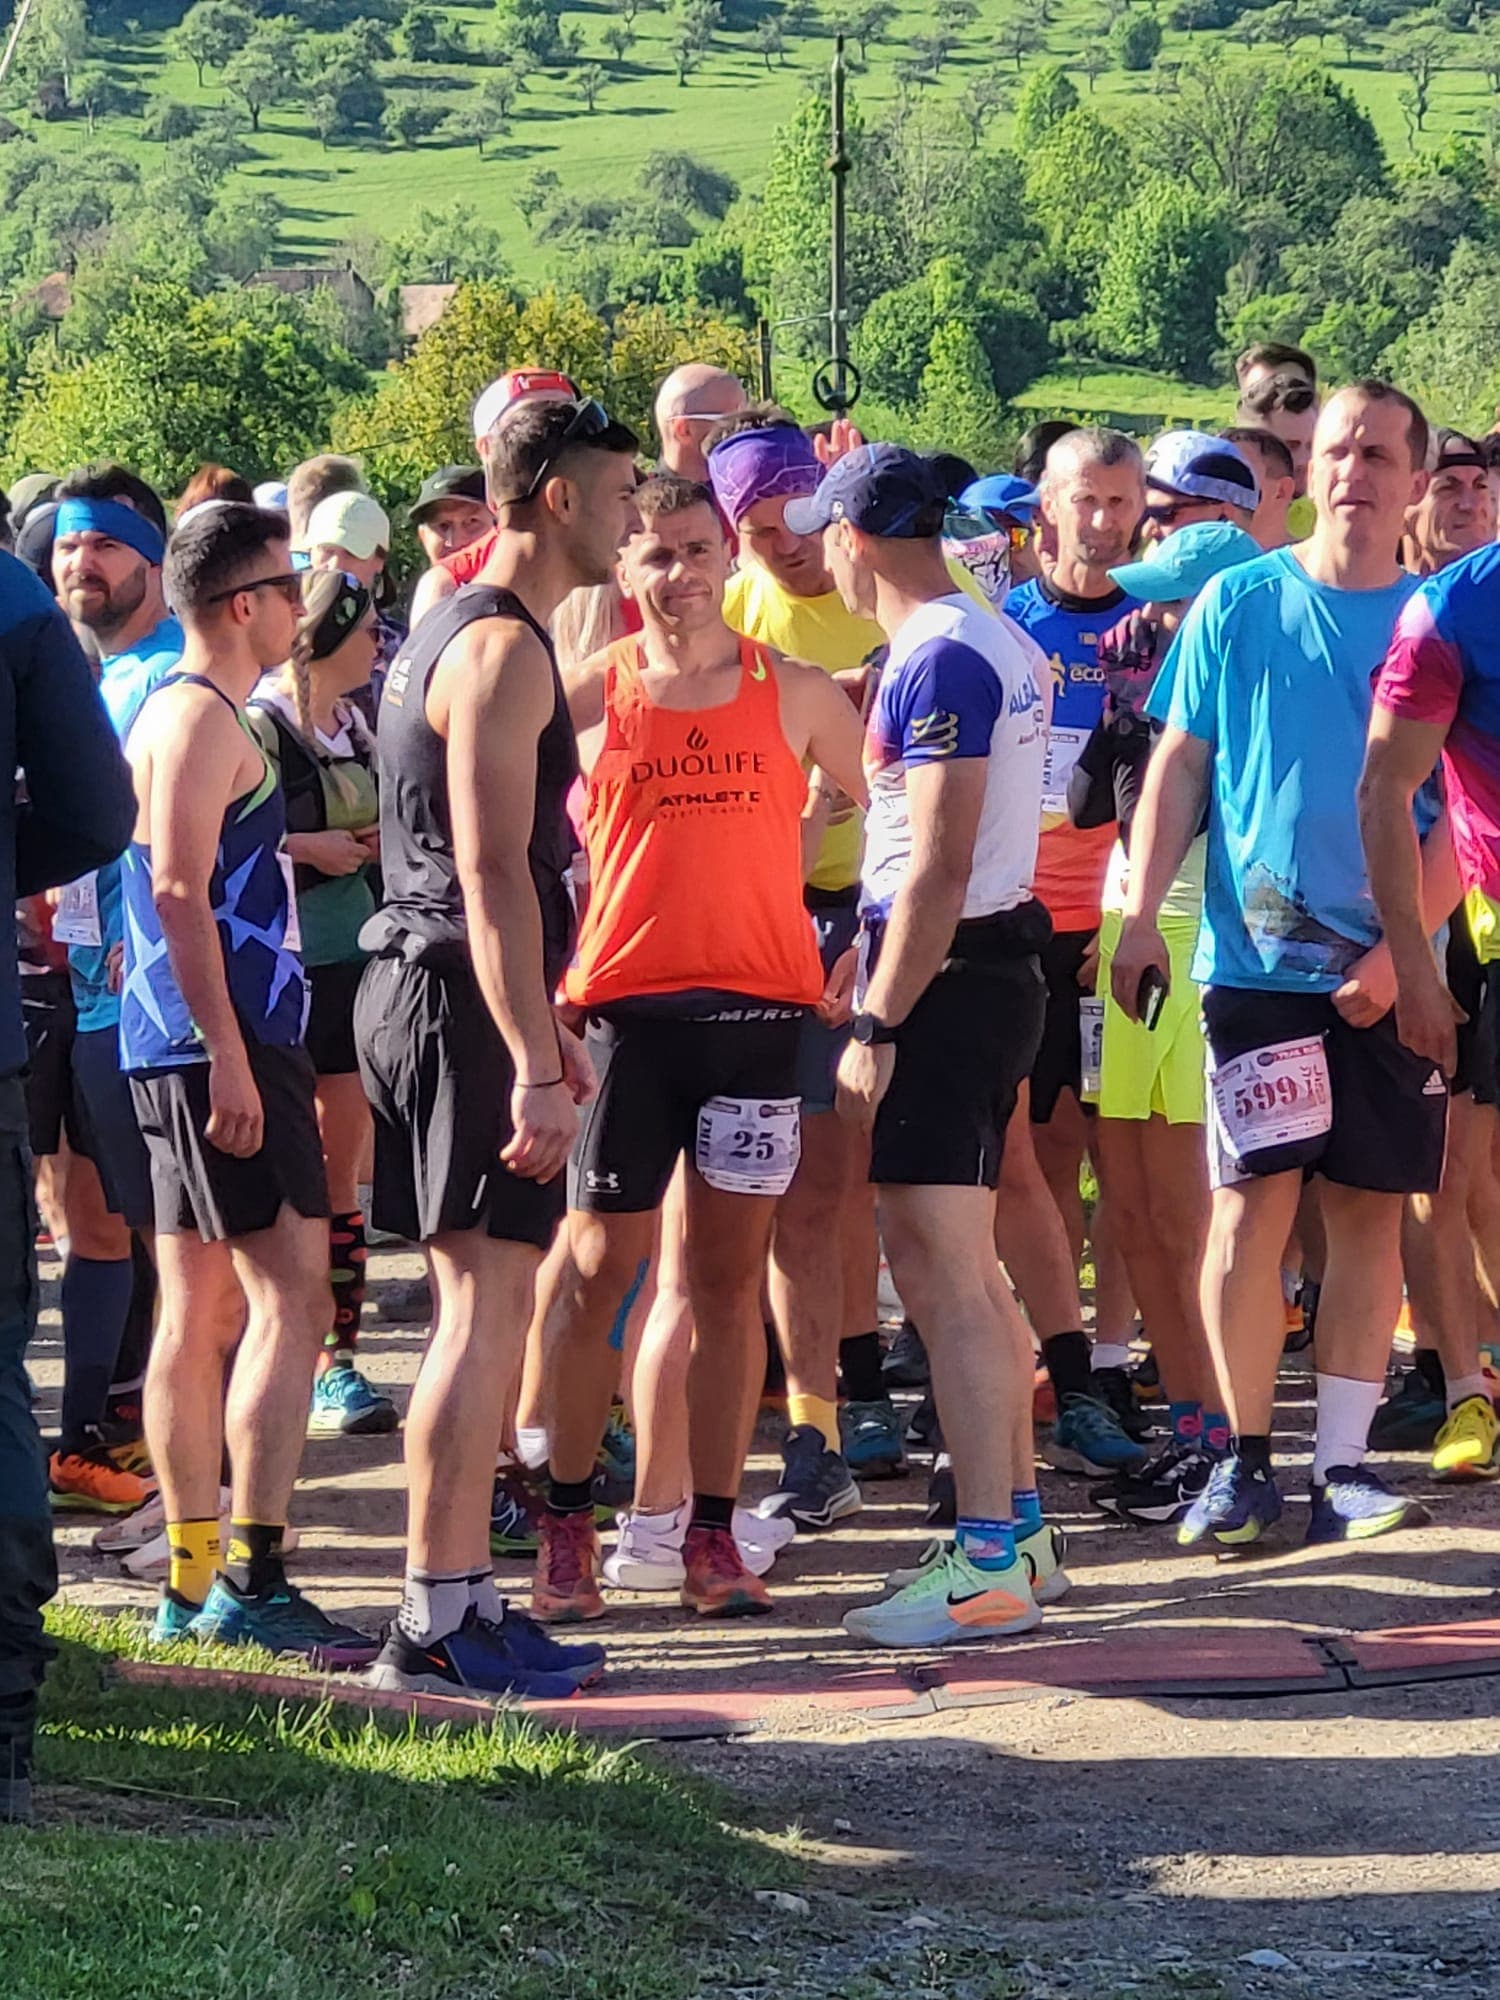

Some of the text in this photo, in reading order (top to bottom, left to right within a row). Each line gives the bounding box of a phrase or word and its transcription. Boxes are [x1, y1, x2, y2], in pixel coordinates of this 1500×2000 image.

[631, 751, 768, 784] DUOLIFE
[1233, 1076, 1298, 1119] 599
[729, 1130, 775, 1160] 25
